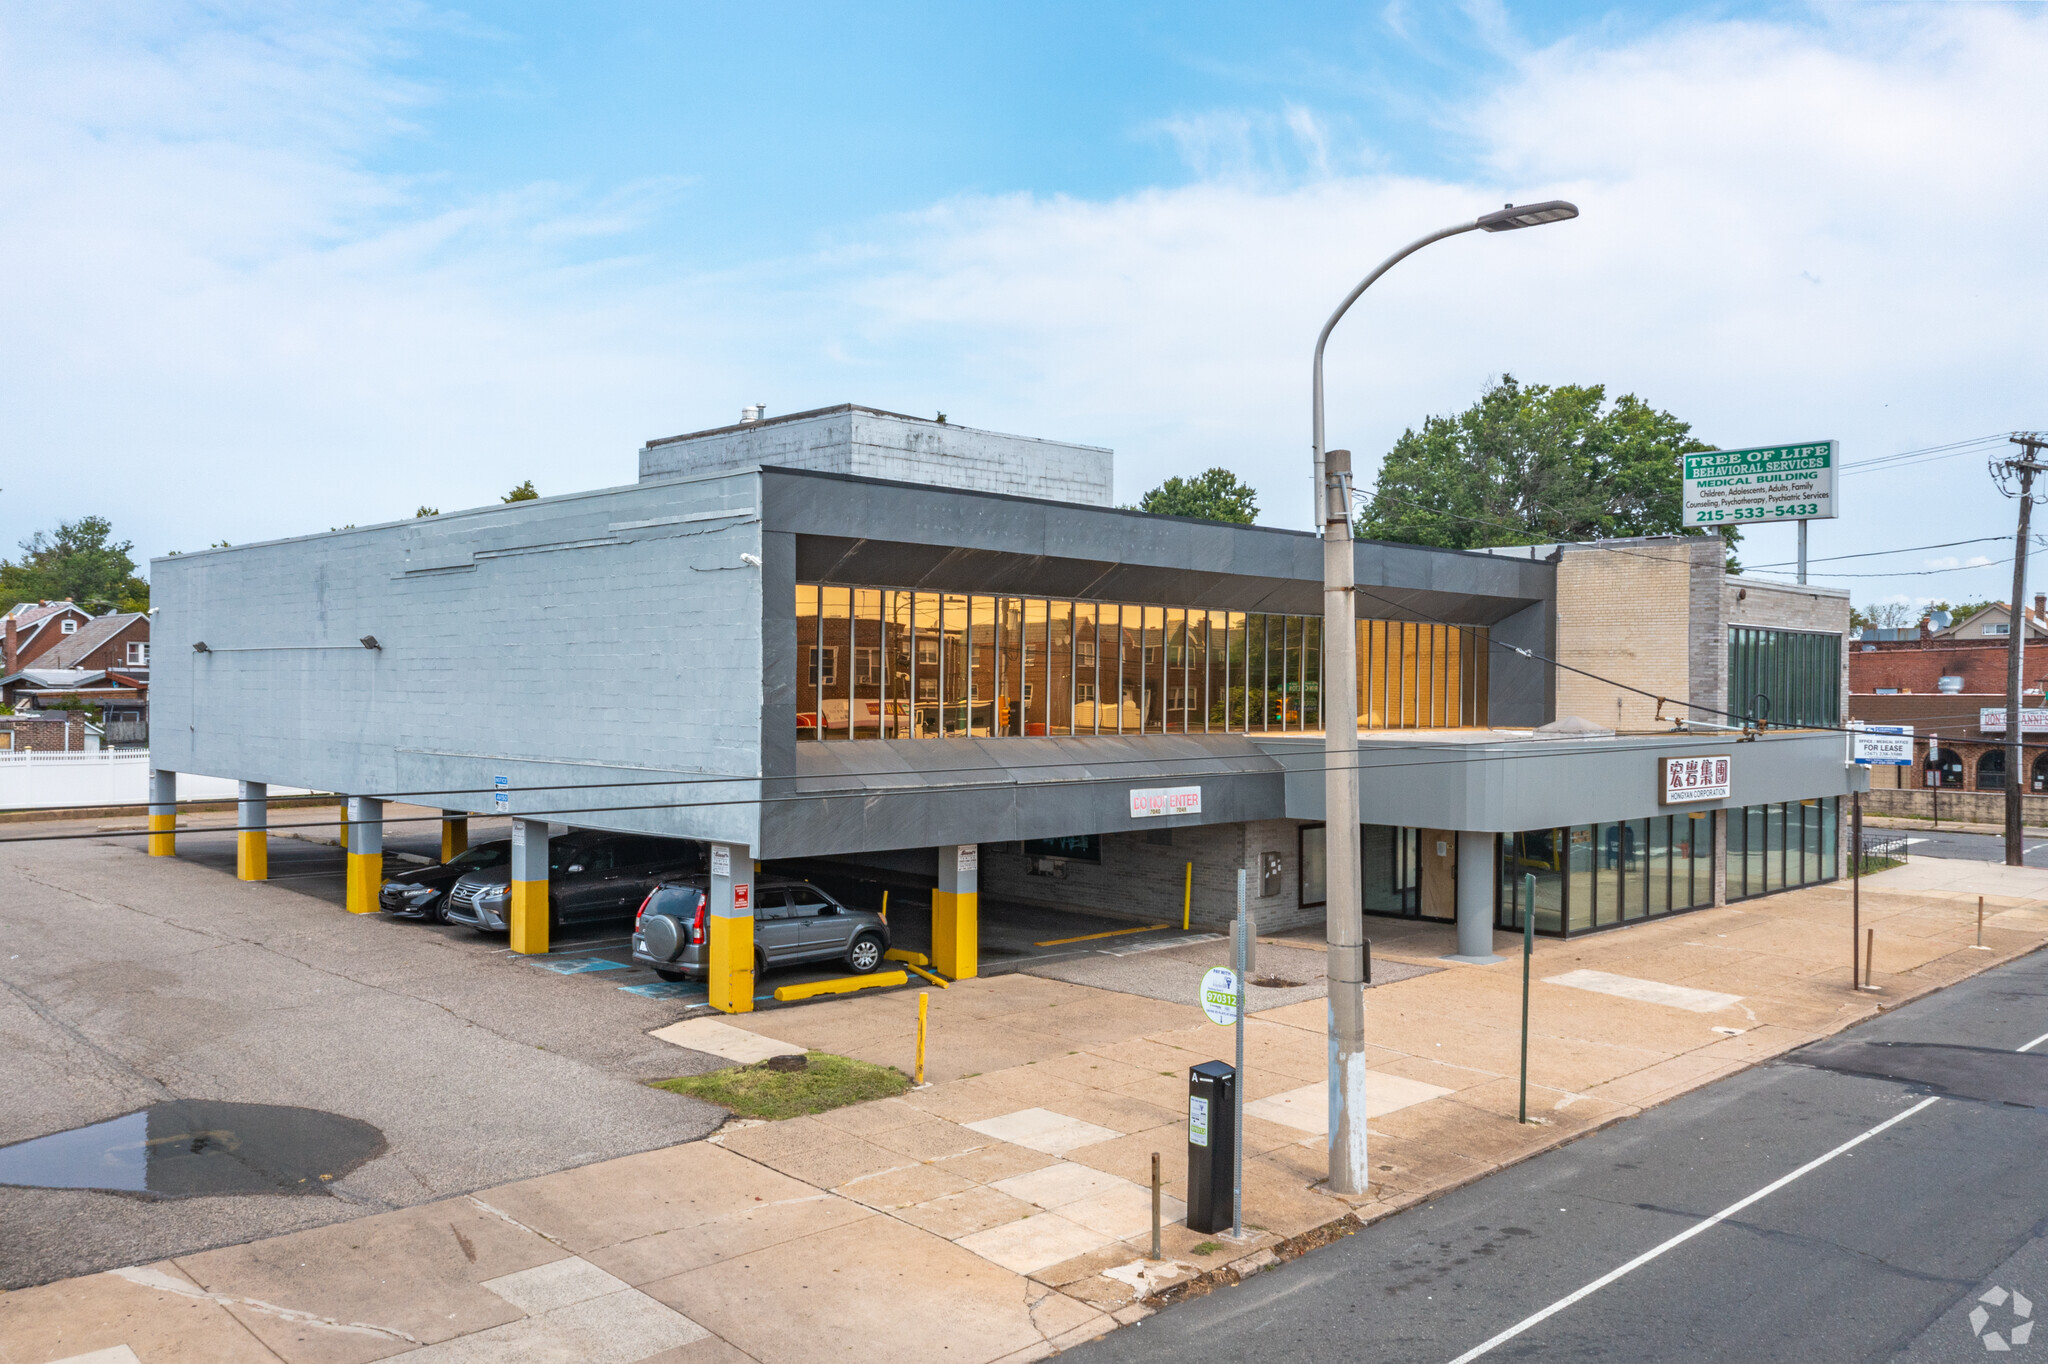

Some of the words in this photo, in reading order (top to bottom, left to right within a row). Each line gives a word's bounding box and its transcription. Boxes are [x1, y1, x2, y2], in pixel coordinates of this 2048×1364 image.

[1688, 454, 1742, 468] TREE
[1747, 450, 1775, 462] OF
[1780, 445, 1829, 460] LIFE
[1693, 463, 1763, 478] BEHAVIORAL
[1765, 457, 1824, 472] SERVICES
[1697, 477, 1752, 488] MEDICAL
[1756, 471, 1818, 484] BUILDING
[1700, 488, 1727, 499] Children,
[1728, 486, 1767, 496] Adolescents,
[1768, 484, 1791, 493] Adults,
[1792, 481, 1814, 491] Family
[1686, 498, 1720, 509] Counseling,
[1721, 496, 1767, 507] Psychotherapy,
[1768, 492, 1800, 503] Psychiatric
[1803, 491, 1829, 500] Services
[1696, 503, 1818, 522] 215-533-5433
[1669, 759, 1728, 788] 宏岩集團
[1133, 796, 1147, 810] DO
[1169, 793, 1199, 808] ENTER
[1670, 791, 1694, 801] HONGYAN
[1694, 788, 1726, 799] CORPORATION
[1207, 991, 1237, 1006] 970312
